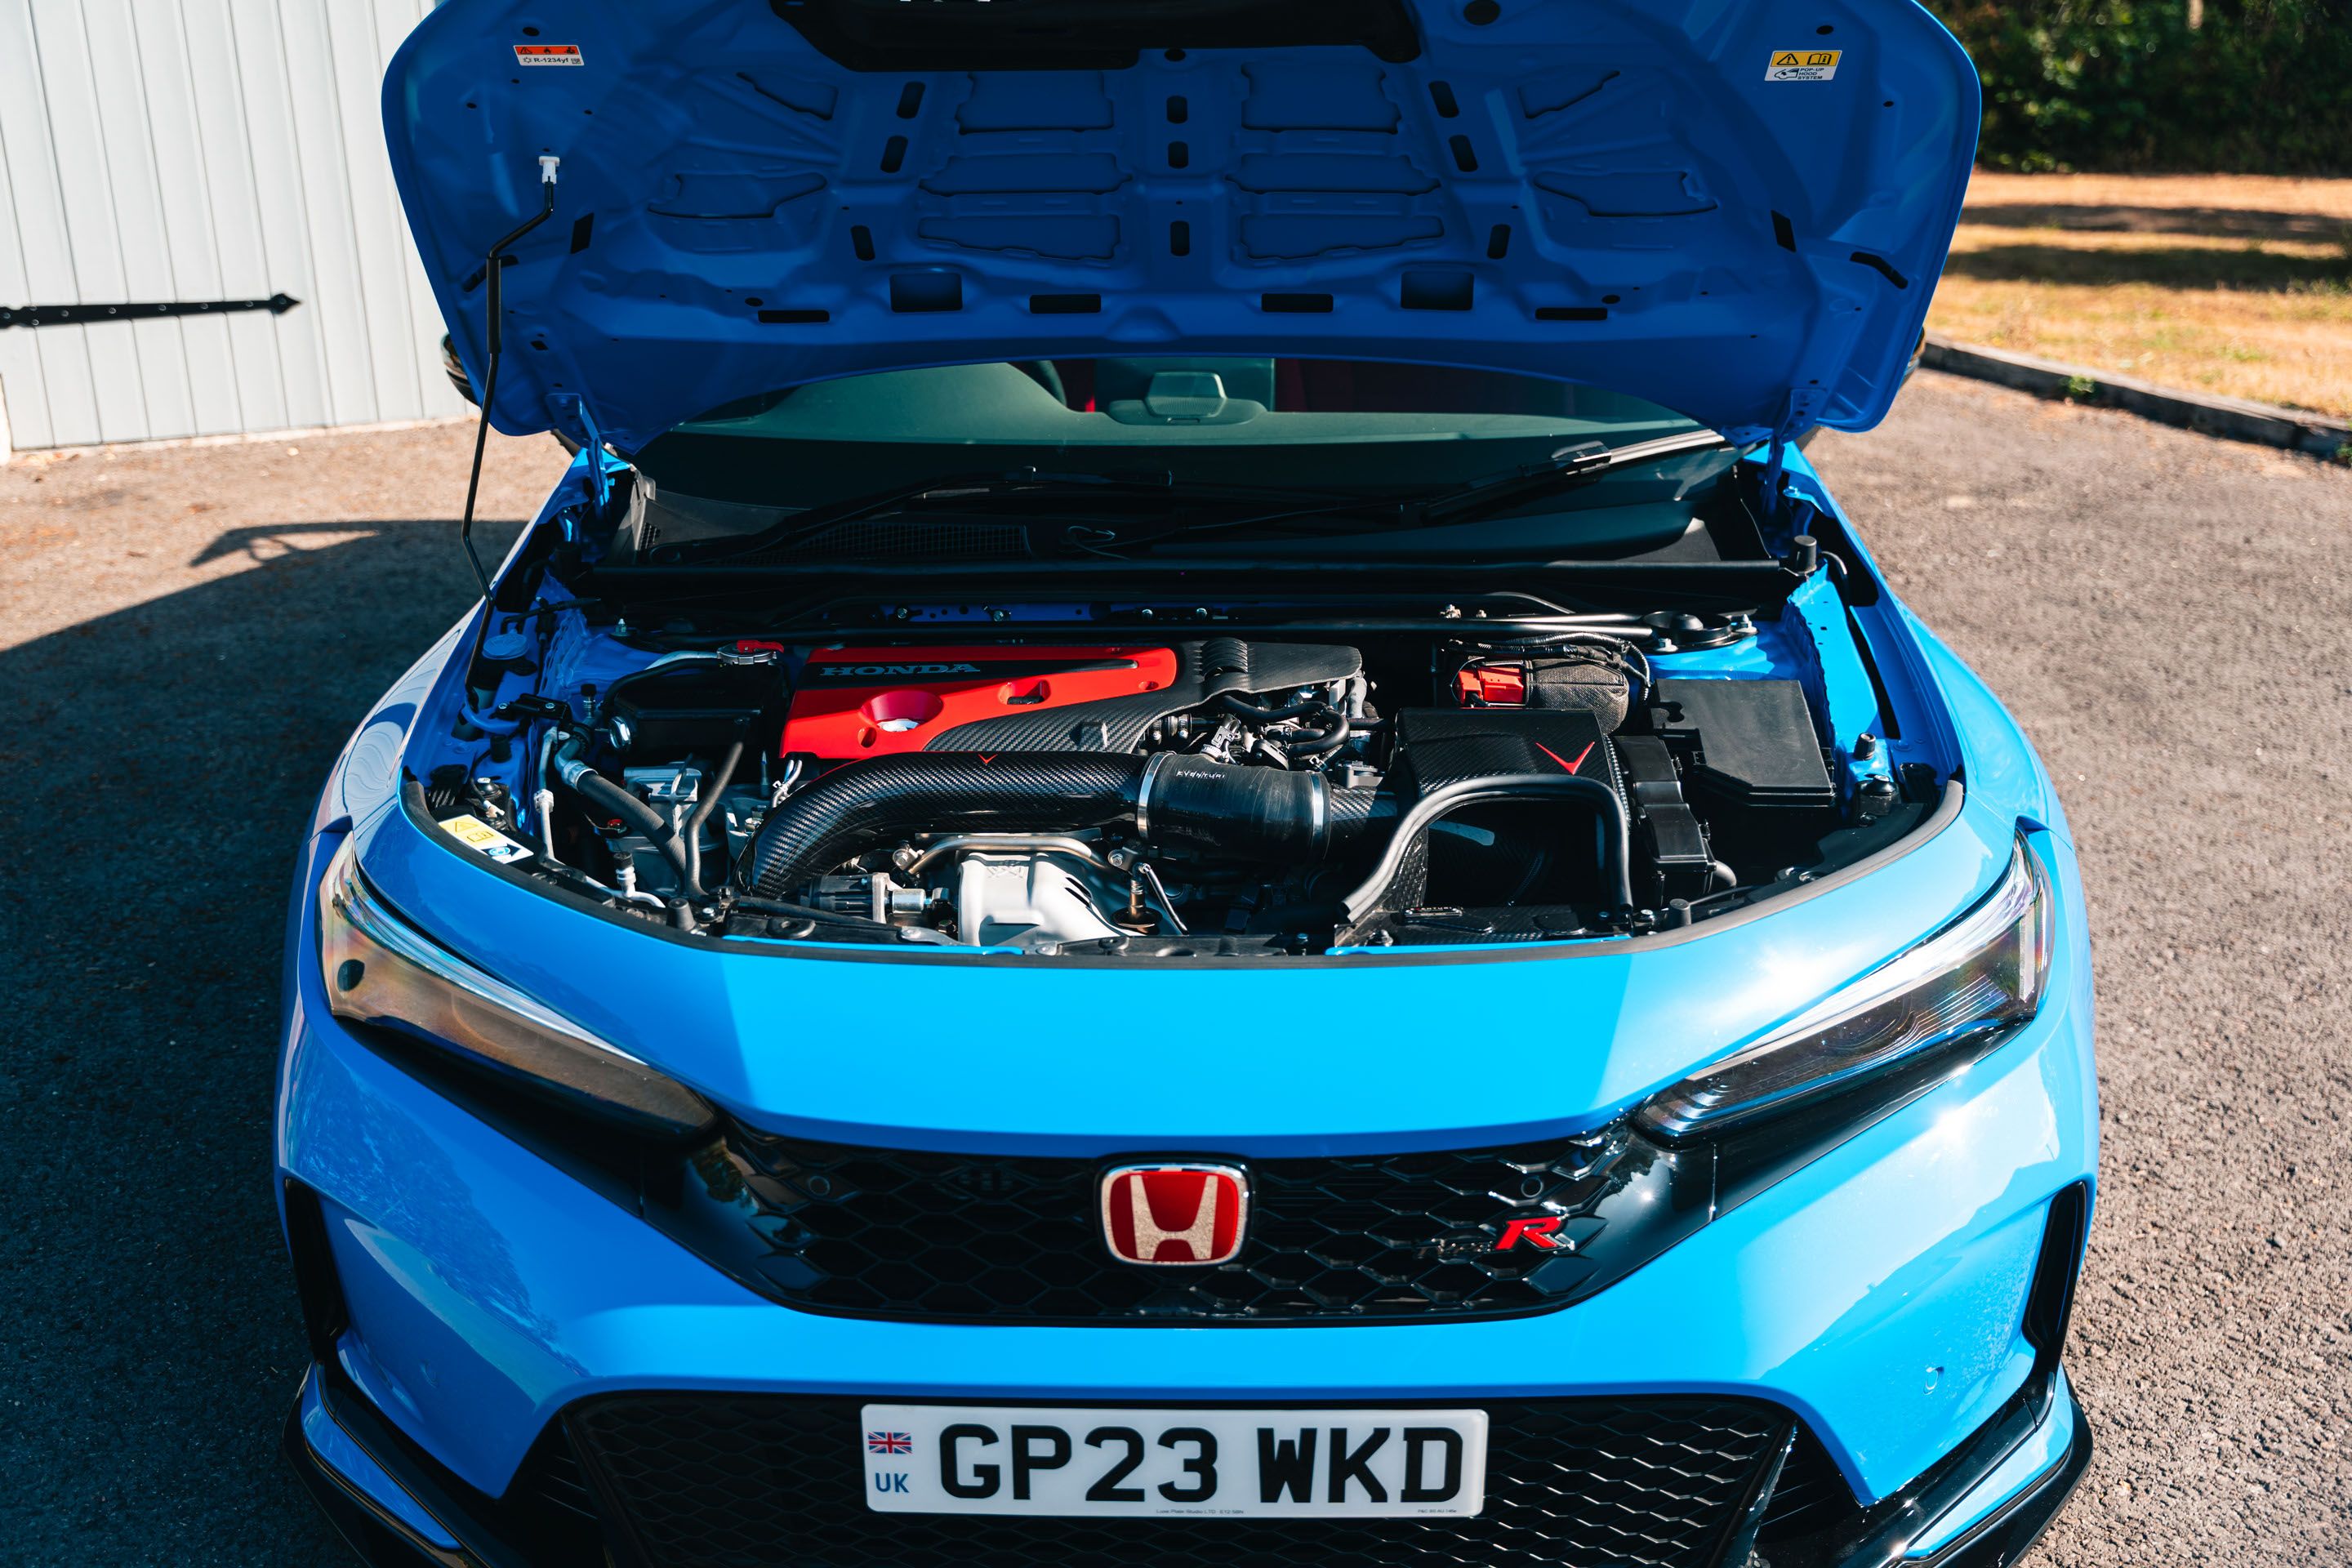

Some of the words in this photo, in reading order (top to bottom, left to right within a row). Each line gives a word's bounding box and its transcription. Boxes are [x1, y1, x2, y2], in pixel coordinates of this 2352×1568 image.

[819, 663, 981, 676] HONDA
[939, 1423, 1218, 1503] GP23
[1257, 1427, 1463, 1503] WKD
[875, 1472, 910, 1494] UK
